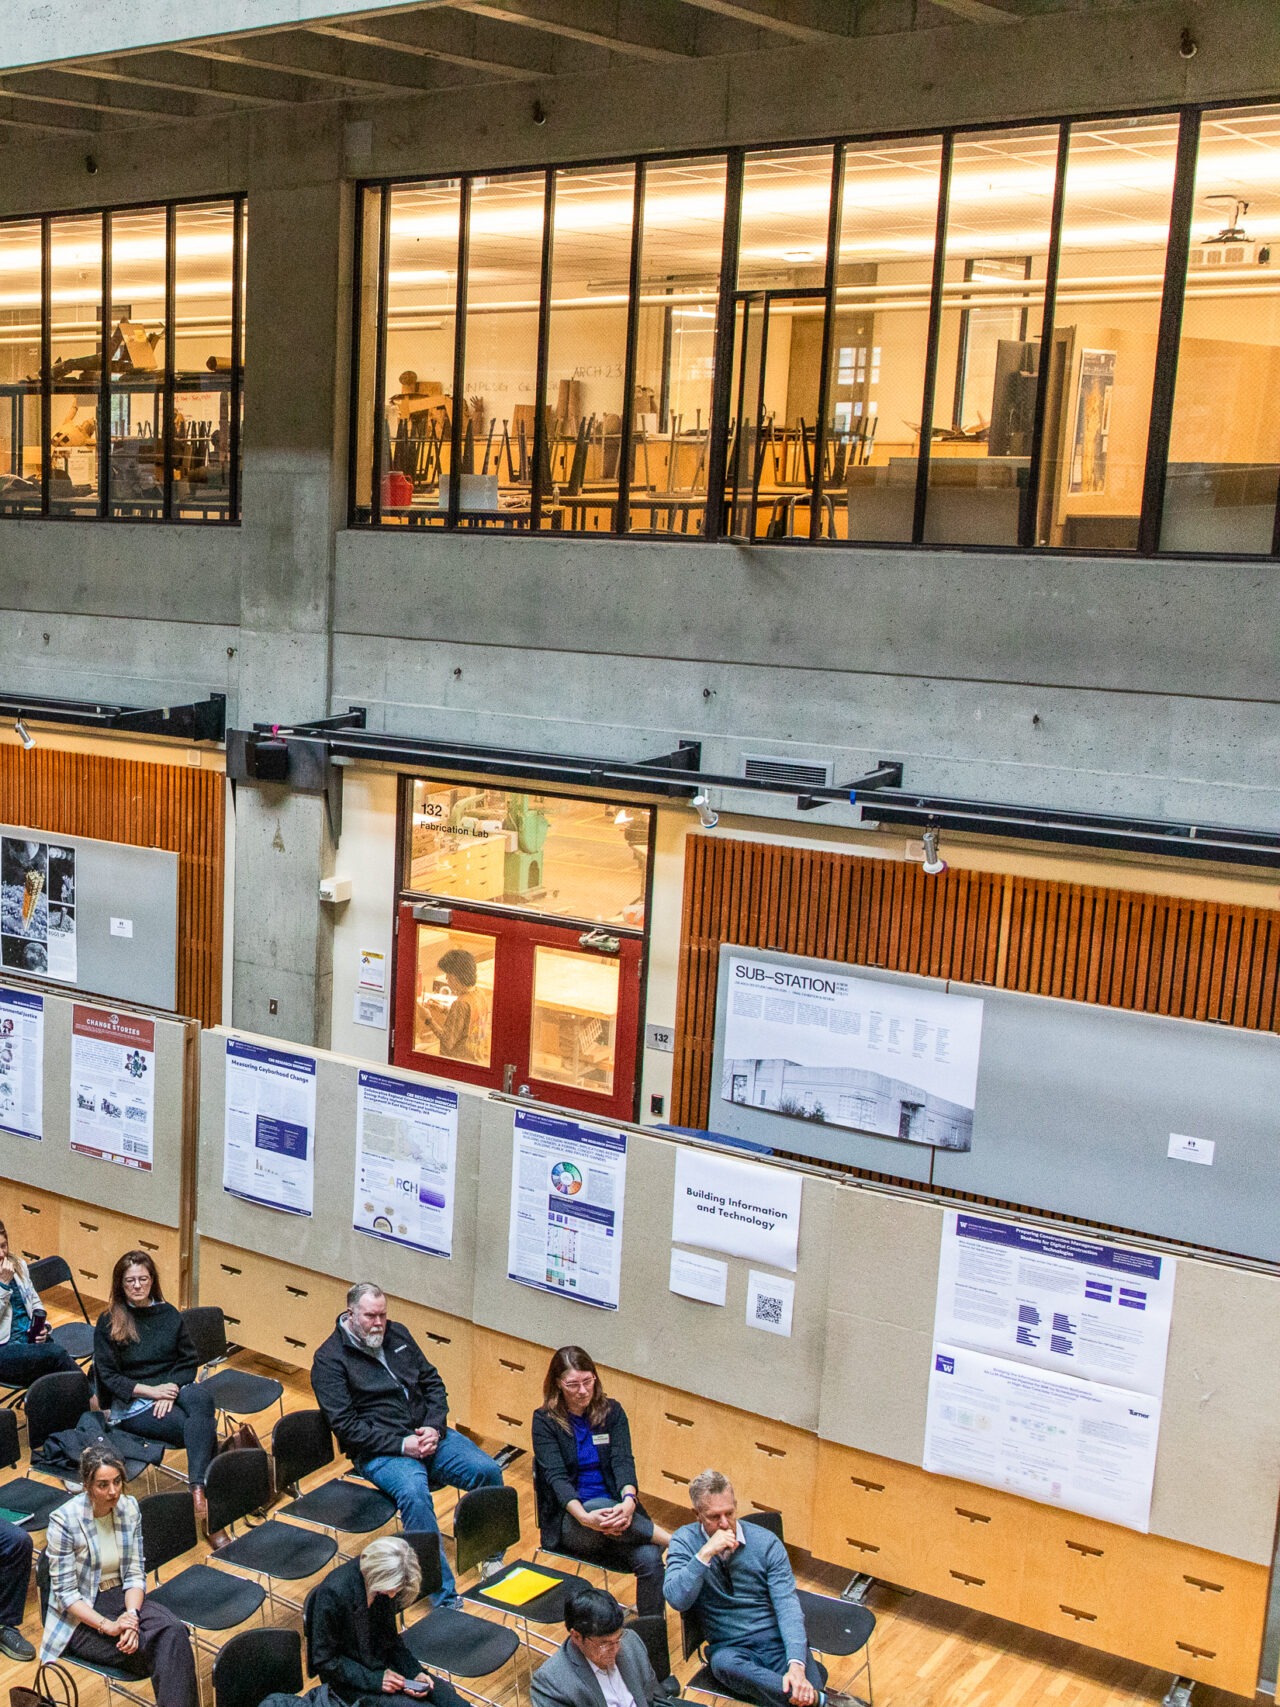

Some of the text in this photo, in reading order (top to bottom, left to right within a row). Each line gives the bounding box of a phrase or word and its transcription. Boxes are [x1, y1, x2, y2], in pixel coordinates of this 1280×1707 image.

[421, 803, 442, 817] 132
[420, 821, 489, 838] Fabrication Lab
[86, 1018, 111, 1030] CHANGE
[113, 1025, 140, 1036] STORIES
[653, 1032, 669, 1044] 132
[231, 1059, 309, 1083] Measuring Gayborhood Change
[361, 1073, 369, 1081] W
[517, 1111, 526, 1119] W
[388, 1174, 419, 1195] ARCH
[686, 1187, 788, 1220] Building Information
[696, 1203, 775, 1231] and Technology
[1015, 1228, 1039, 1238] Preparing
[1039, 1233, 1070, 1244] Construction
[1070, 1239, 1104, 1252] Management
[1020, 1235, 1041, 1244] Students
[1050, 1241, 1066, 1249] Digital
[1066, 1245, 1098, 1256] Construction
[1042, 1246, 1074, 1257] Technologies
[942, 1363, 953, 1373] W
[1128, 1408, 1150, 1419] Turner
